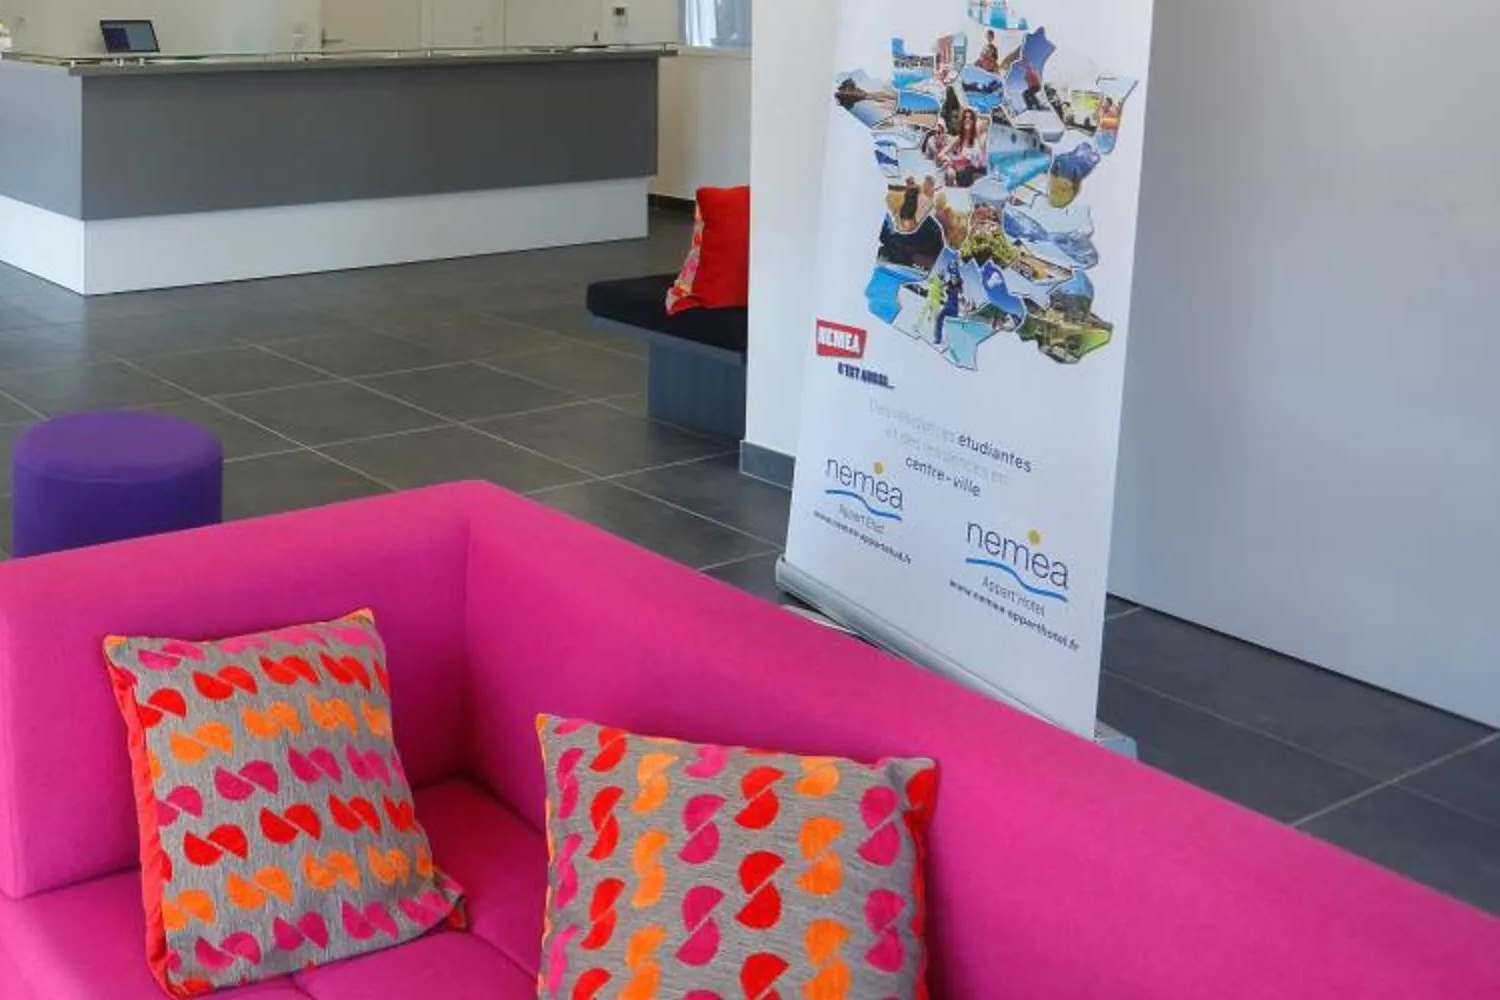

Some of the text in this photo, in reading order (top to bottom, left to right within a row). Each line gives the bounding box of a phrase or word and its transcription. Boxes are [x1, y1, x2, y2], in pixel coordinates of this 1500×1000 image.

[826, 458, 903, 511] nemea
[905, 455, 981, 497] centre-ville
[967, 521, 1069, 590] nemea
